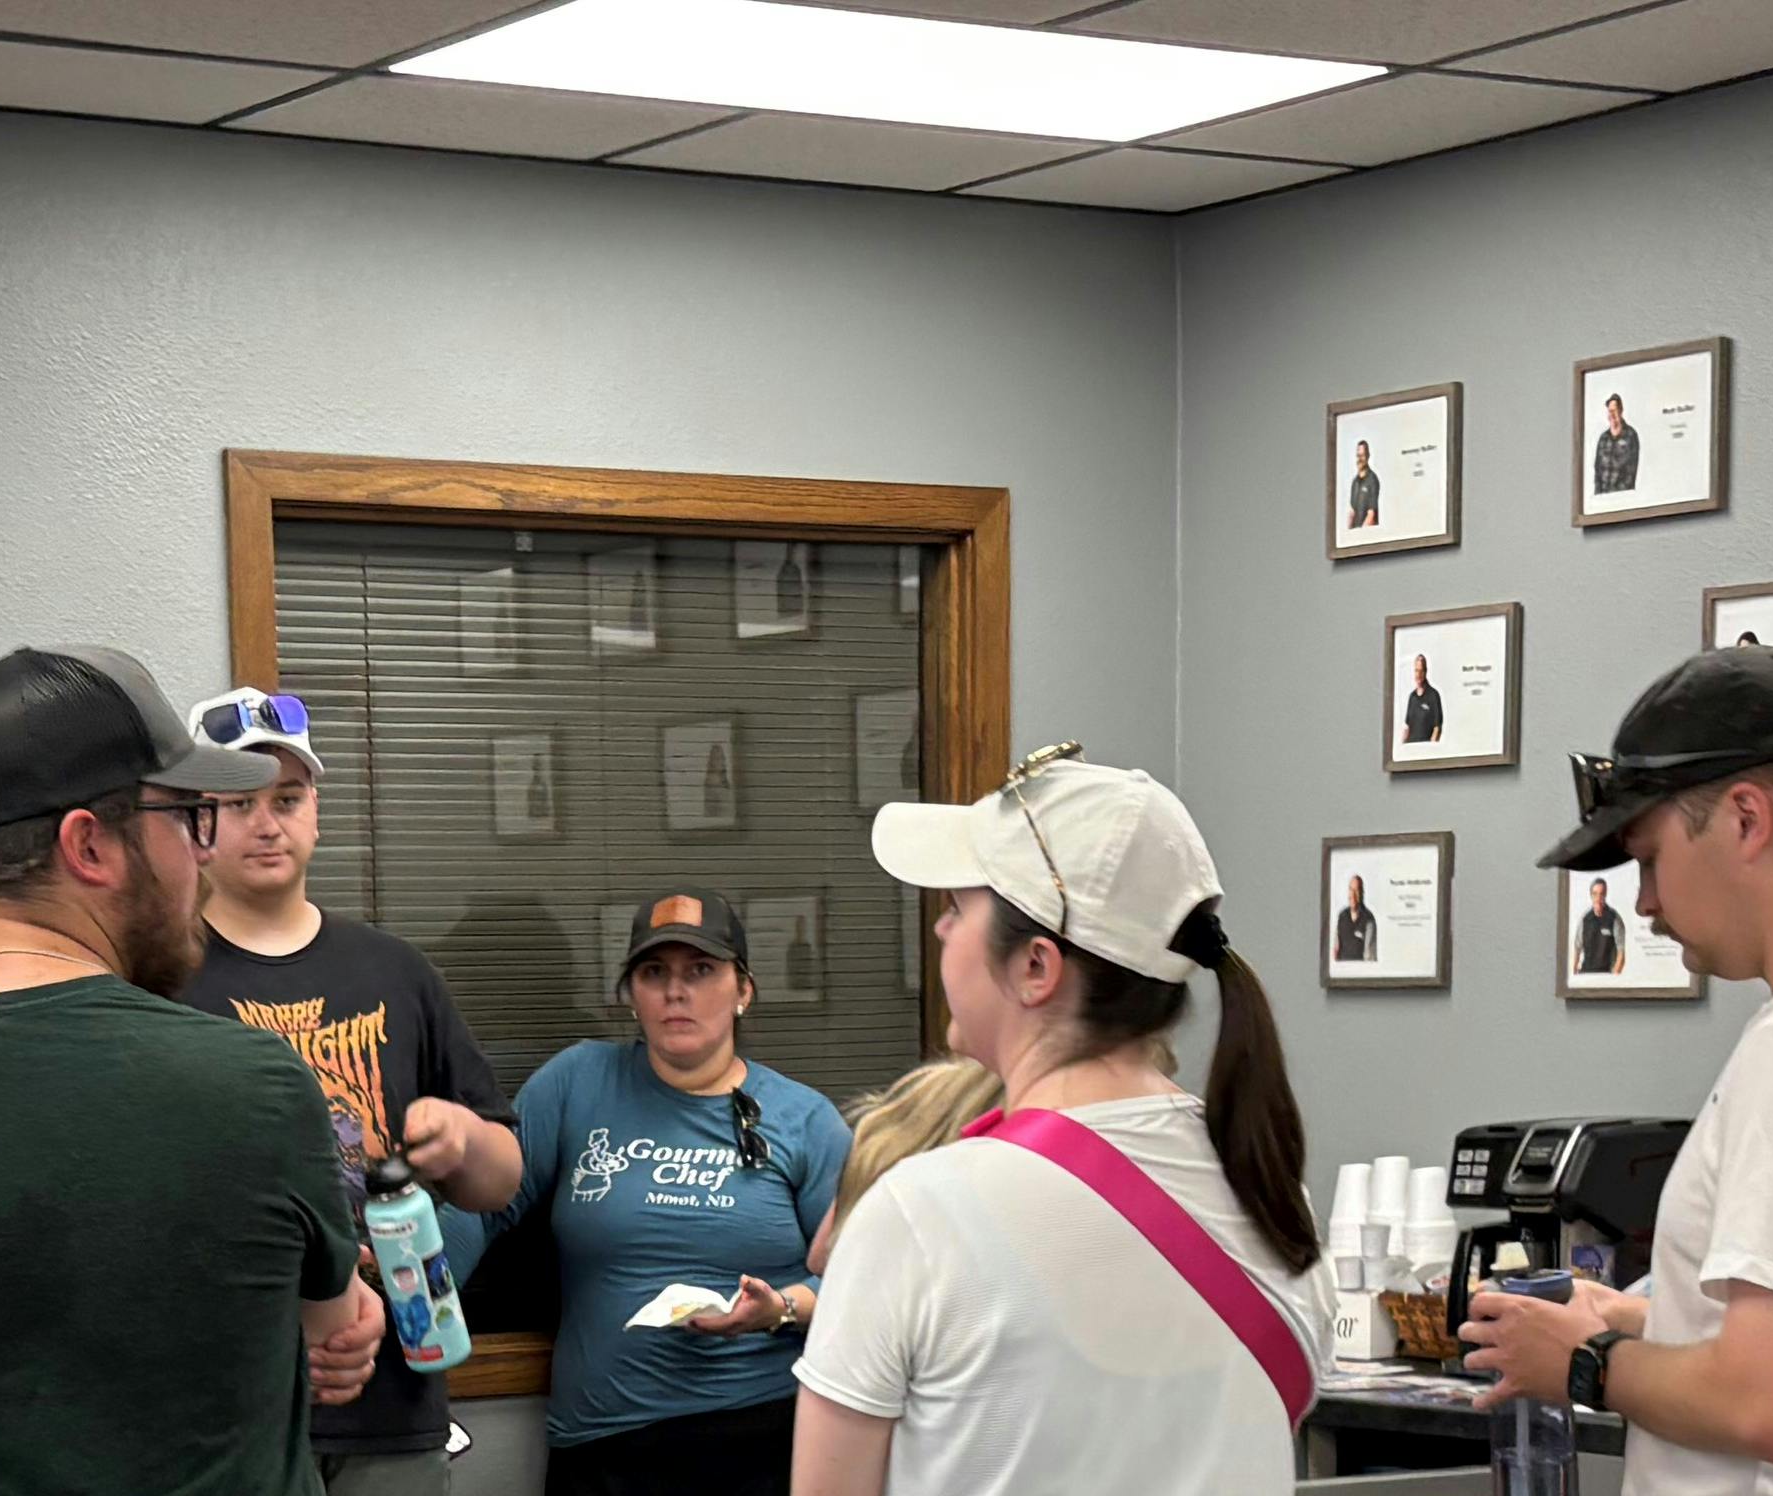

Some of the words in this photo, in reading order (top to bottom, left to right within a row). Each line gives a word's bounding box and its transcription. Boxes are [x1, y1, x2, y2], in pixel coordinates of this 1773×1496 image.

[626, 1138, 744, 1168] Gourm
[652, 1163, 735, 1192] Chef
[705, 1193, 736, 1209] ND
